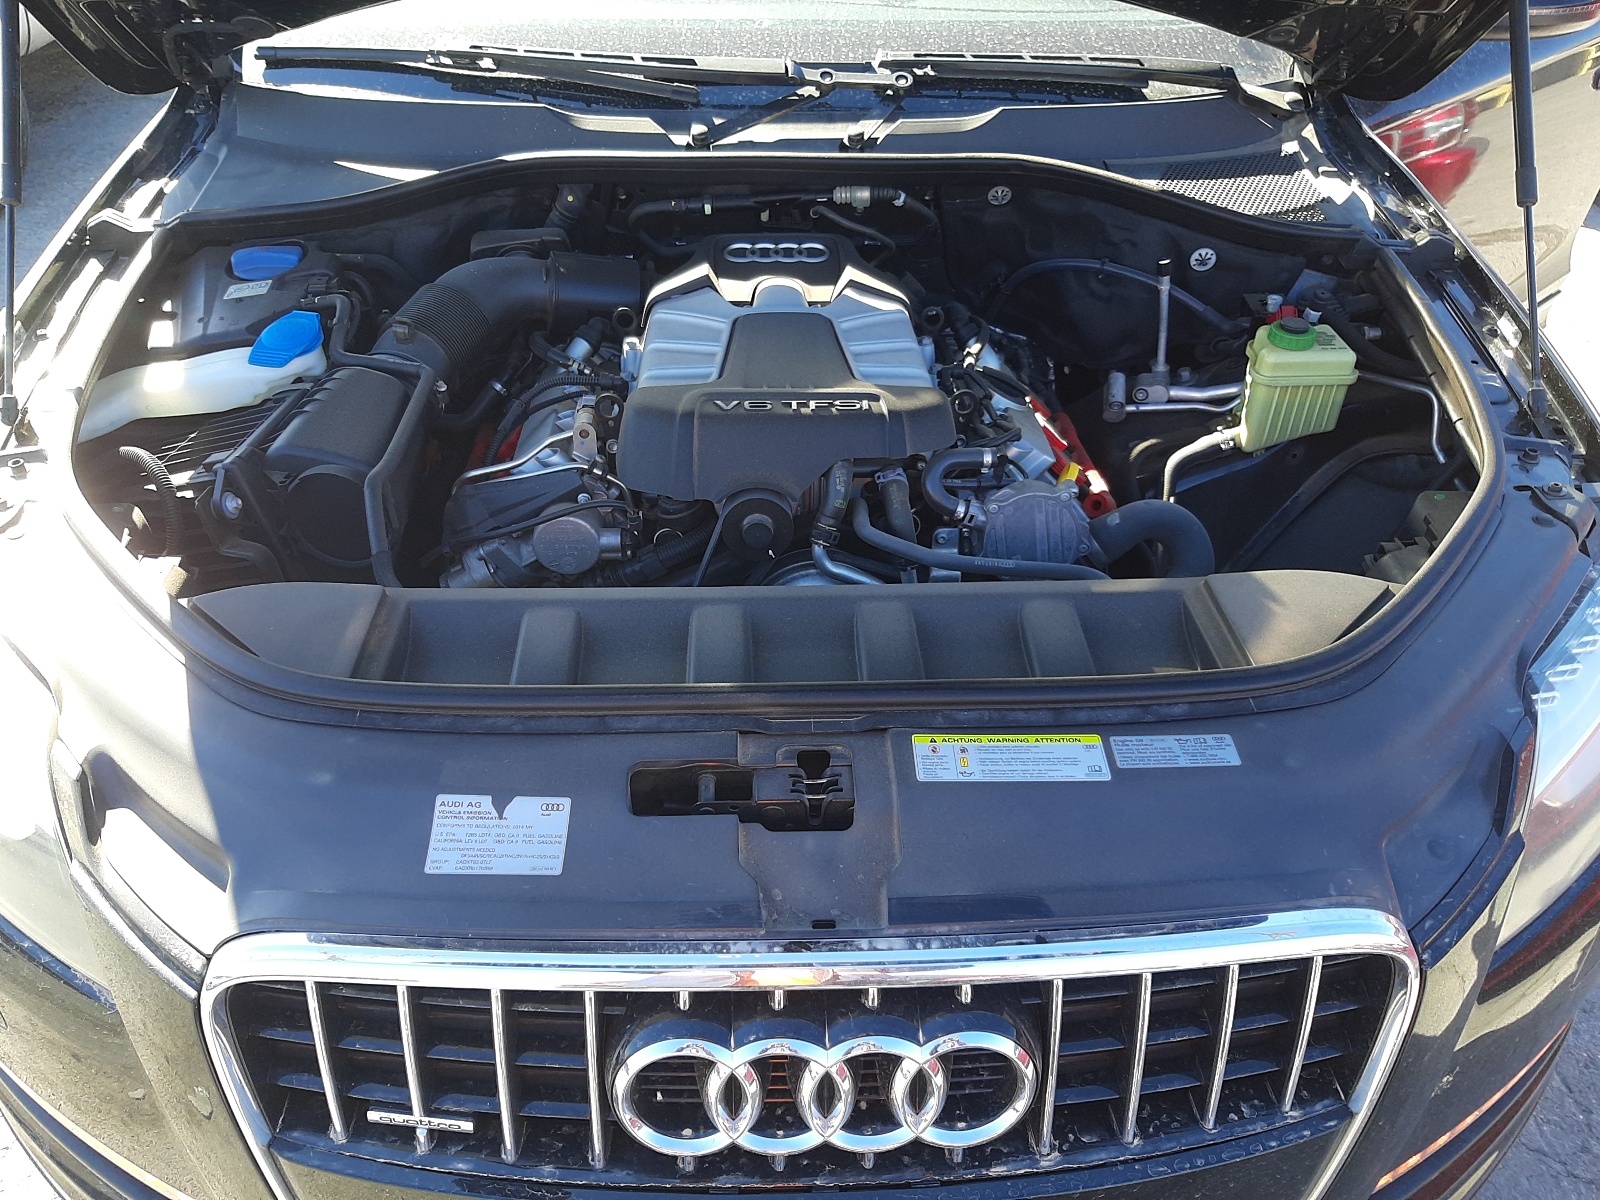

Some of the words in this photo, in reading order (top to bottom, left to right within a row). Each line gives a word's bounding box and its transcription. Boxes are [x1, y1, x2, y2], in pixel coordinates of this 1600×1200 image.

[713, 399, 773, 412] V6
[781, 399, 872, 412] TFSI
[438, 800, 464, 808] AUDI
[466, 801, 482, 809] AG
[379, 1116, 462, 1130] quattro
